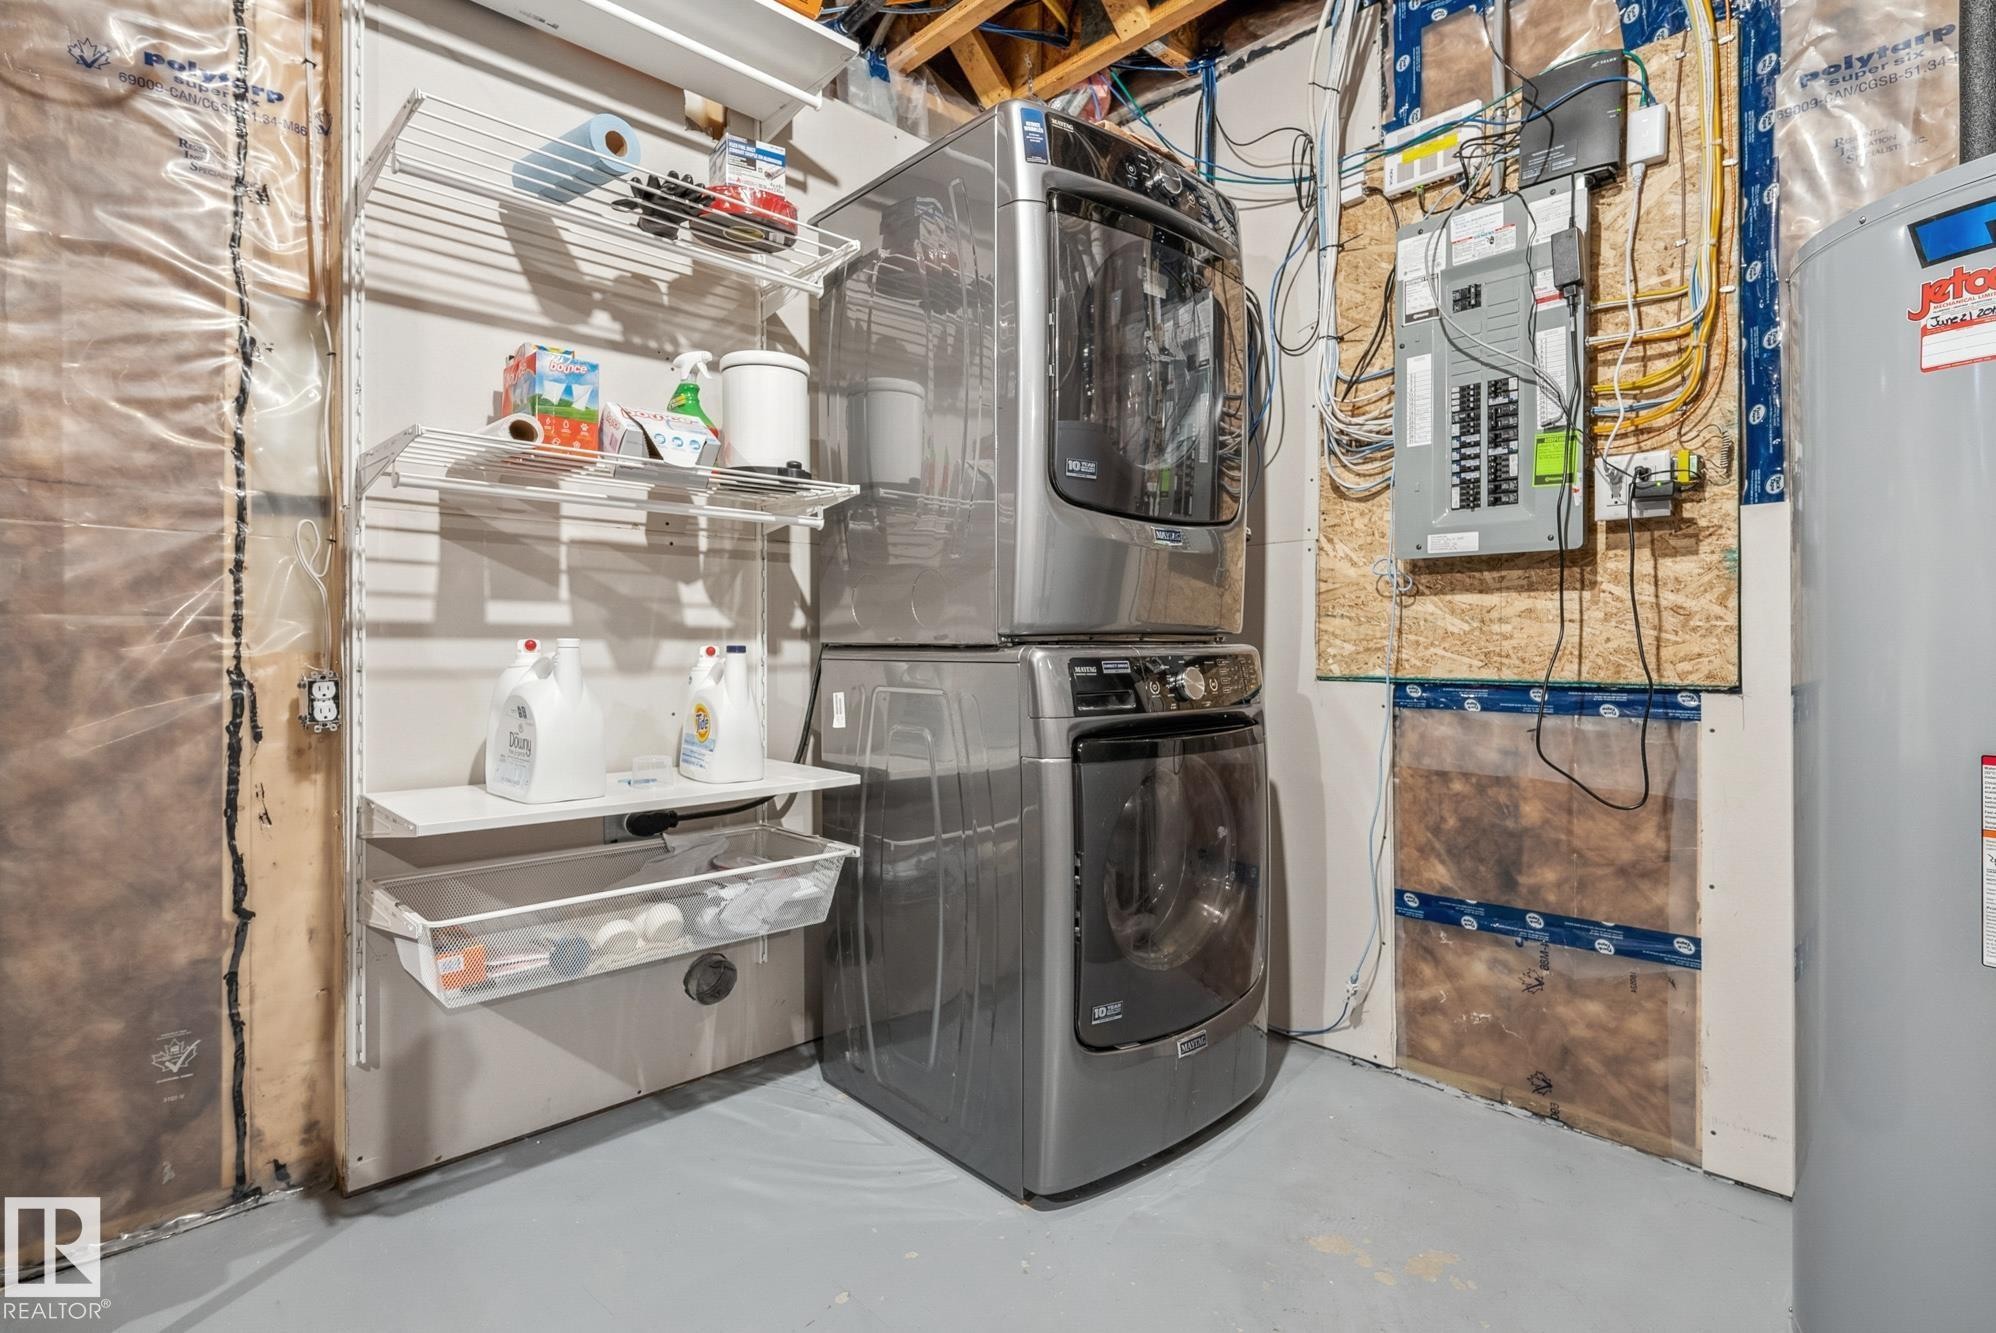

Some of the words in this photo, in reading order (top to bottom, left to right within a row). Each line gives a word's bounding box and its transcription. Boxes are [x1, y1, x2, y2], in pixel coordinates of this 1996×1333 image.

[1799, 23, 1957, 88] polytarp
[1829, 62, 1890, 87] super
[1894, 49, 1926, 67] six
[1933, 295, 1977, 310] MECHANICAL
[1929, 315, 1958, 328] June
[549, 361, 588, 375] bounce
[1067, 460, 1081, 472] 10
[695, 712, 709, 734] Tide
[509, 730, 532, 758] Downy
[1094, 1006, 1107, 1019] 10
[1180, 1035, 1206, 1053] MAYTAG
